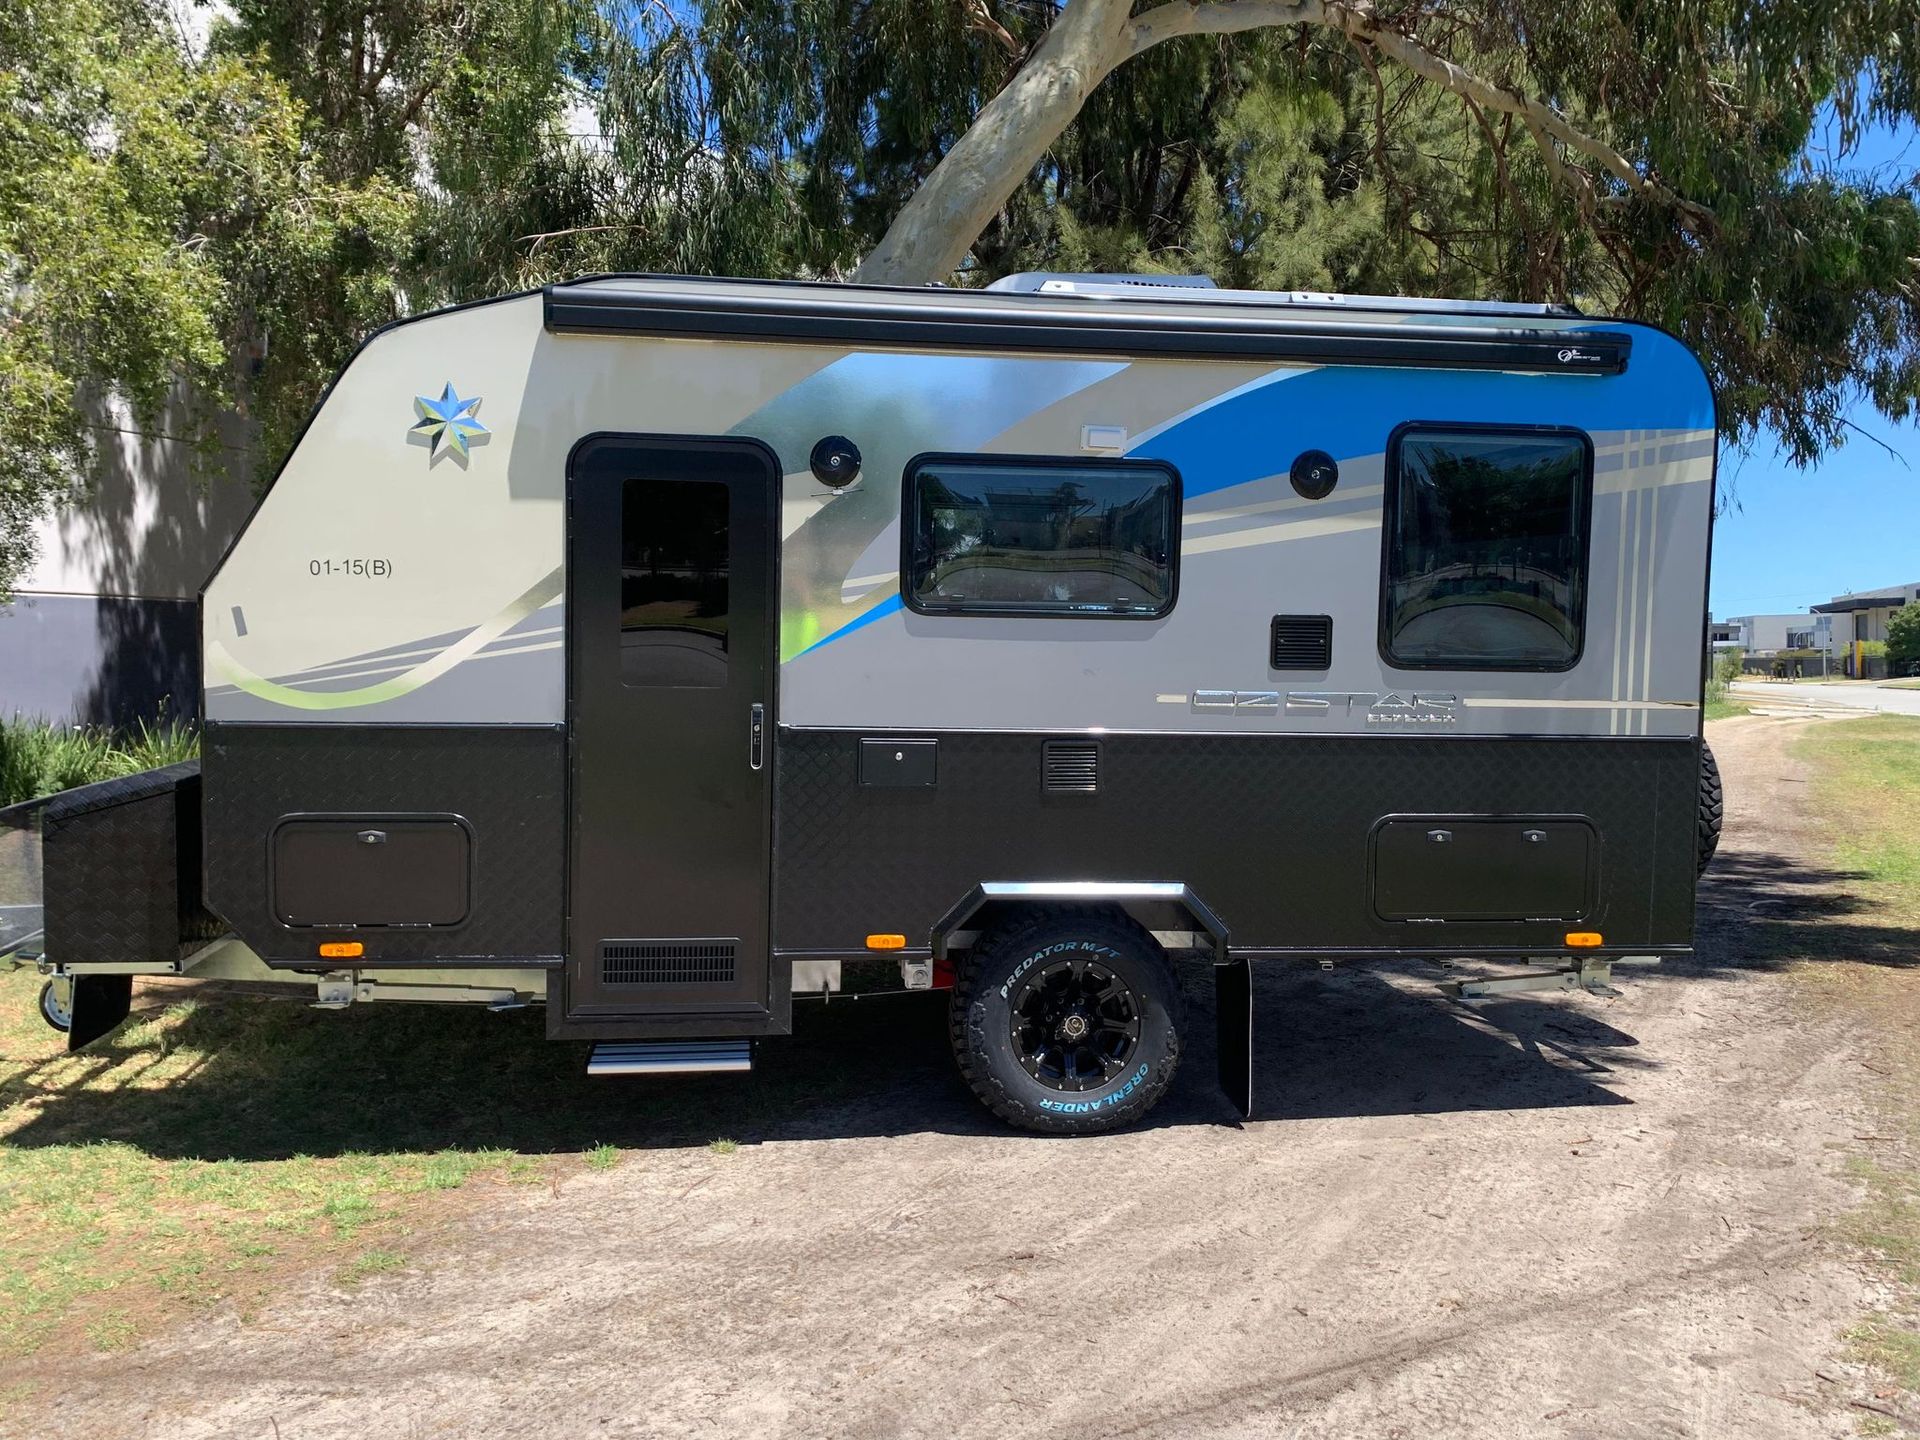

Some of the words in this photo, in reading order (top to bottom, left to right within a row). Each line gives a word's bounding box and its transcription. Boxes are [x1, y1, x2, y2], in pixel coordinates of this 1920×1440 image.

[309, 558, 392, 579] 01-15(B)
[999, 941, 1077, 999] PREDATOR
[1080, 941, 1122, 959] M/T
[1039, 1063, 1149, 1113] GRENLANDER
